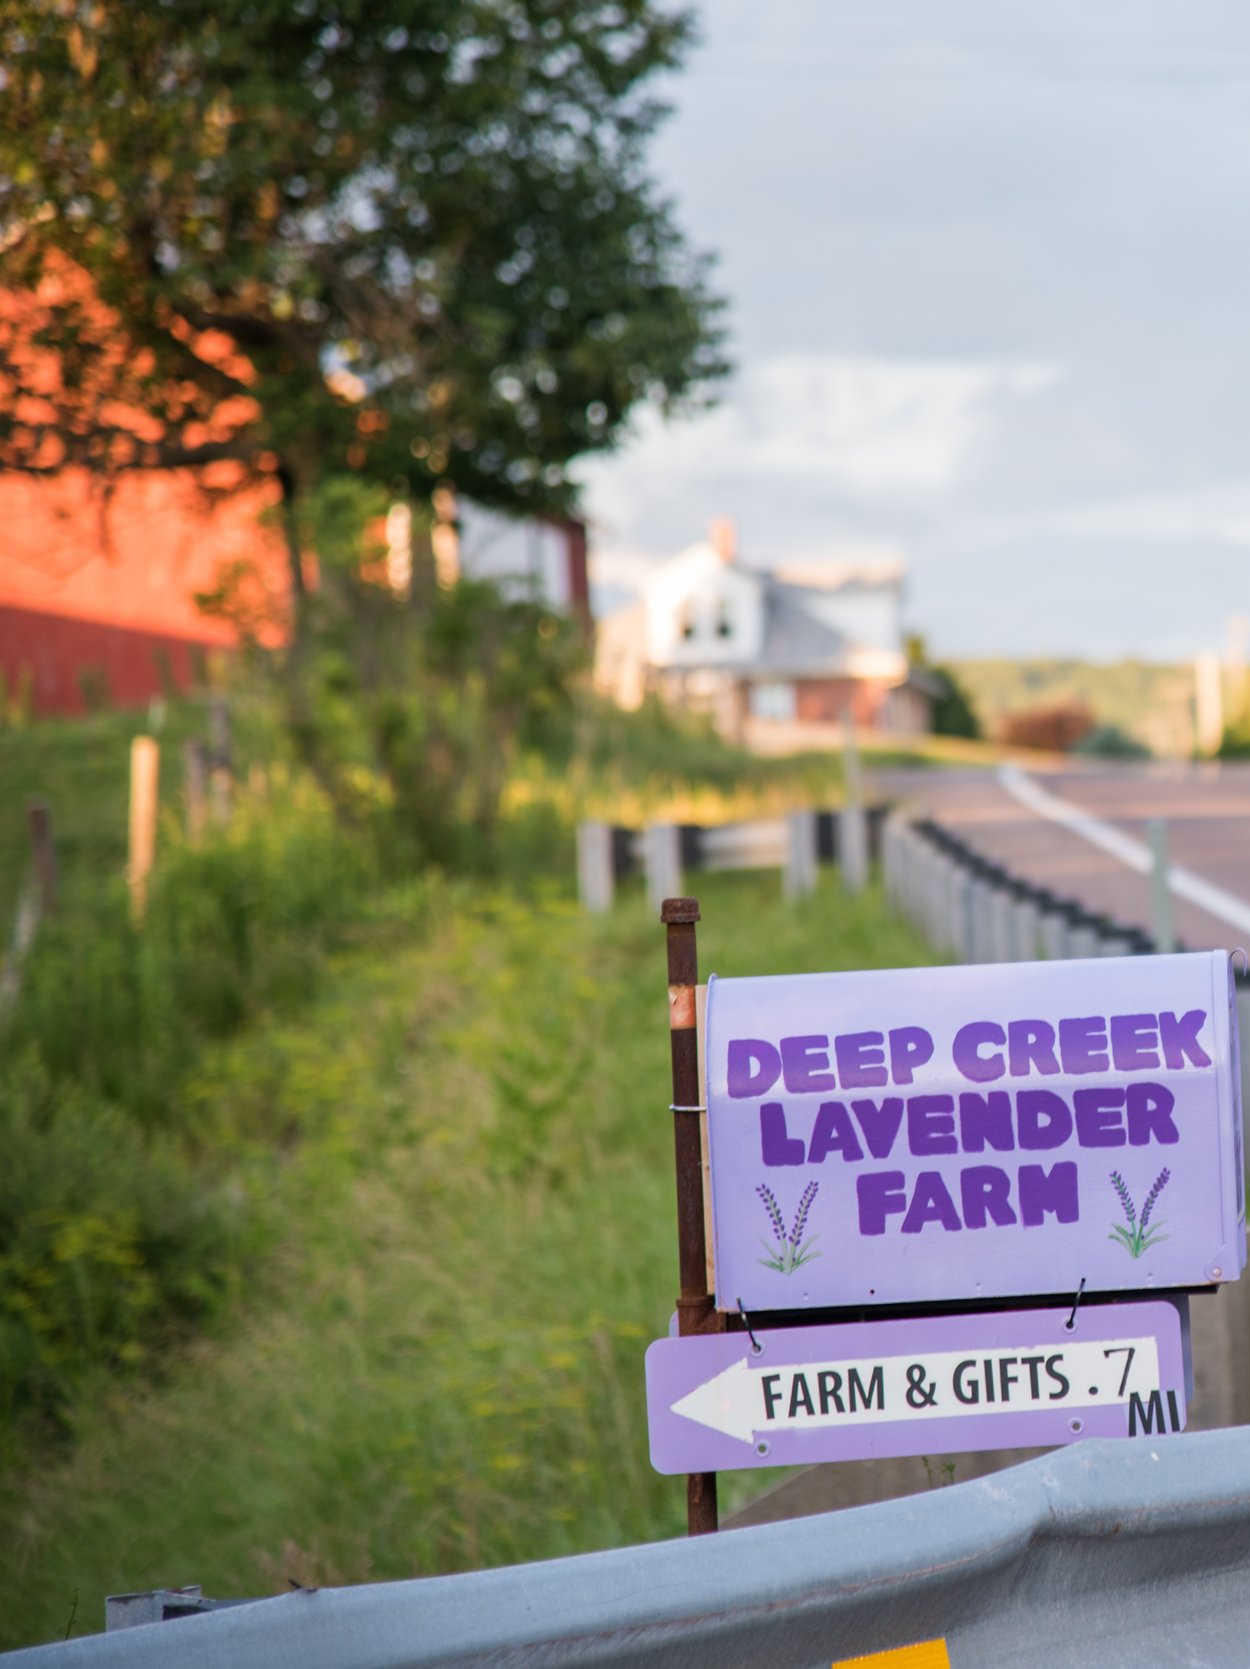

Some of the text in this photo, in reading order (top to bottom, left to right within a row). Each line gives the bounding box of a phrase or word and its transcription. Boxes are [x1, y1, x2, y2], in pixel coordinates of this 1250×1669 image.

[727, 1009, 1212, 1099] DEEP CREEK
[759, 1082, 1180, 1167] LAVENDER
[856, 1162, 1080, 1236] FARM
[761, 1366, 886, 1420] FARM
[905, 1363, 938, 1407] &
[952, 1354, 1071, 1405] GIFTS
[1128, 1390, 1181, 1437] MI
